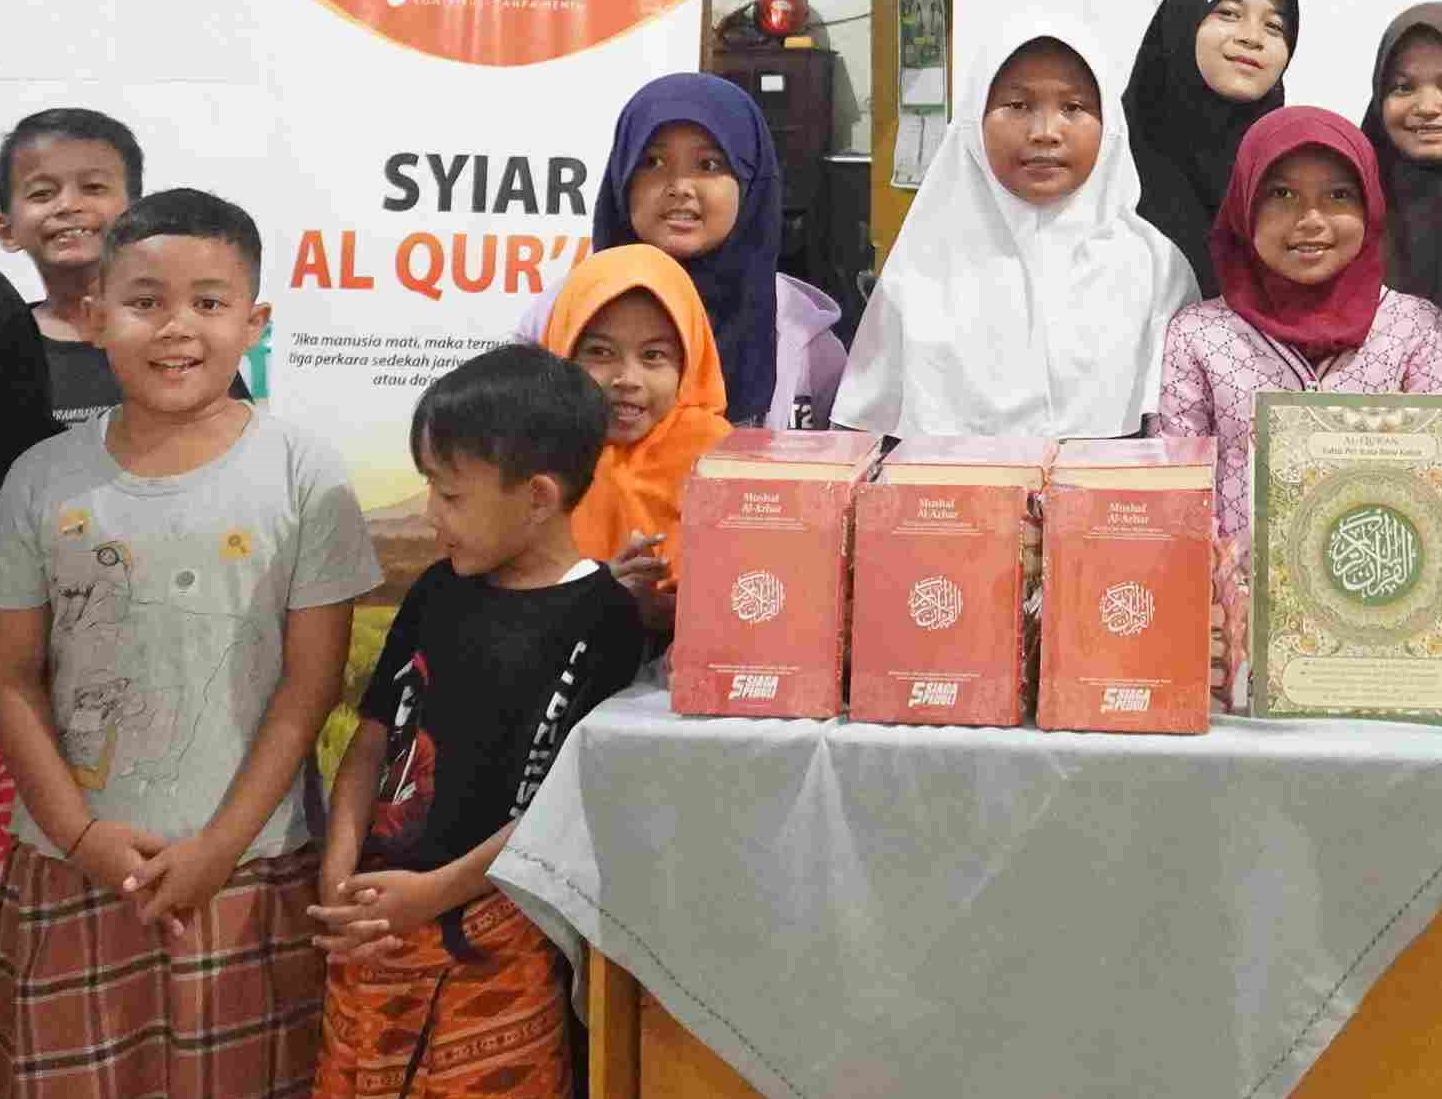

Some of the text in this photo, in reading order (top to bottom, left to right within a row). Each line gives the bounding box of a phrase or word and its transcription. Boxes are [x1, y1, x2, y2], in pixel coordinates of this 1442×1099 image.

[382, 151, 589, 217] SYIAR
[290, 229, 375, 291] AL
[321, 334, 381, 348] manusia
[385, 336, 420, 349] mati,
[425, 336, 463, 349] maka
[289, 353, 313, 368] tiga
[315, 352, 369, 368] perkara
[371, 354, 429, 367] sedekah
[373, 374, 406, 386] atau
